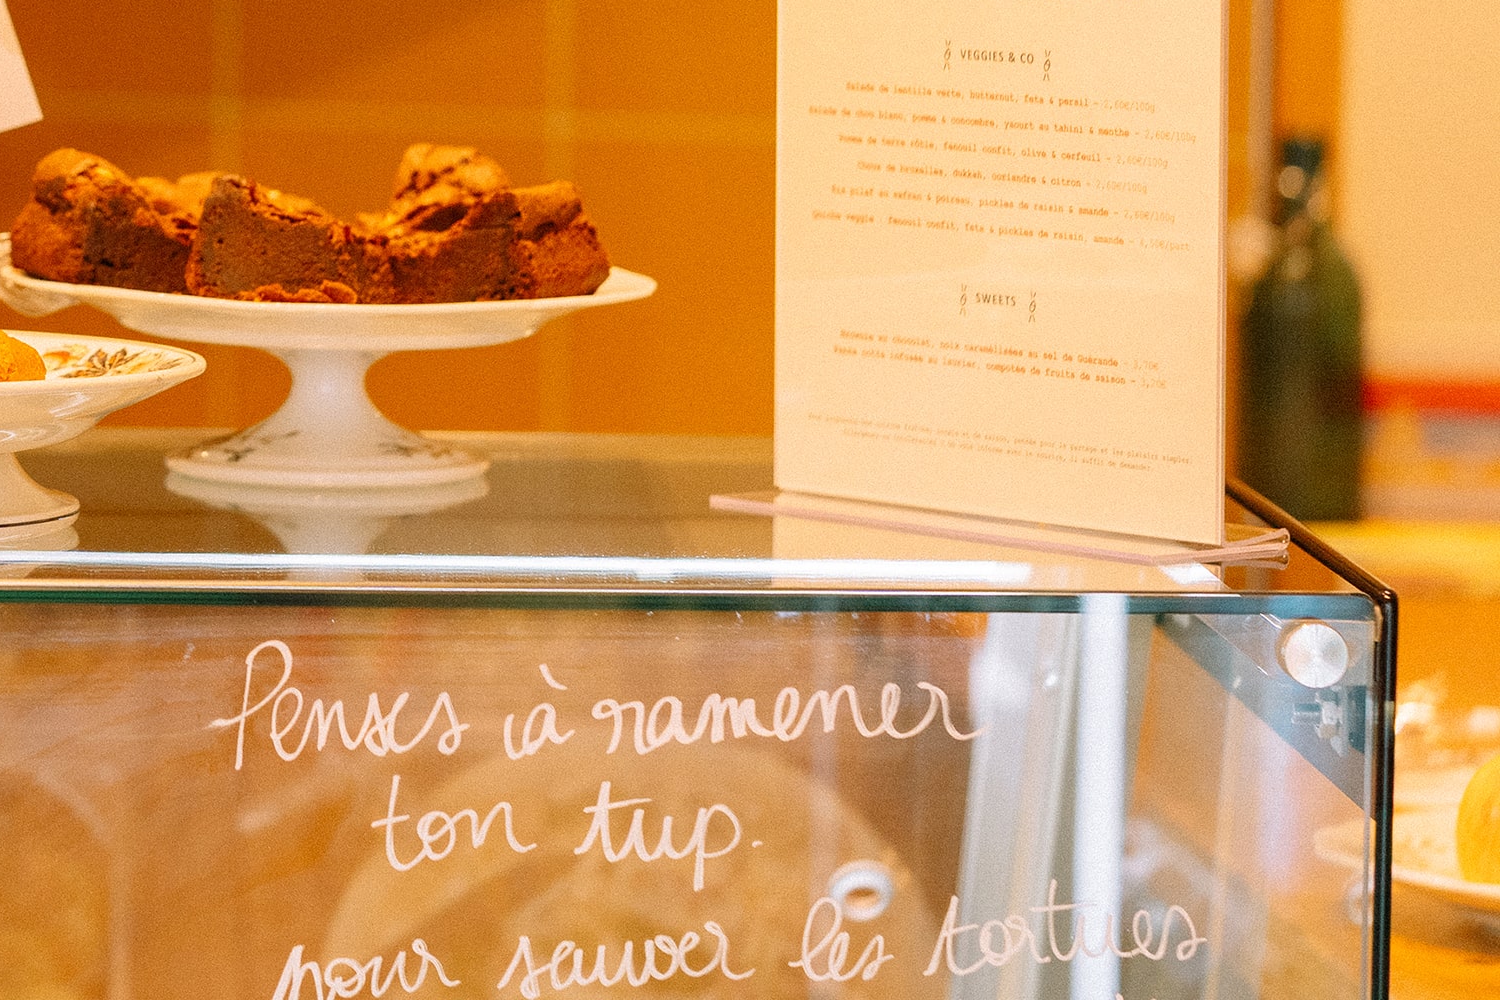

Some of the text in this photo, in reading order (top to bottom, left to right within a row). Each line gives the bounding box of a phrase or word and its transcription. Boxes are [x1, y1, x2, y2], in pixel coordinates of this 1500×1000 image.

[960, 48, 1035, 65] VEGGIES & CO
[975, 291, 1017, 307] SWEETS
[211, 639, 983, 771] Penses à ramener
[371, 774, 765, 892] ton tup.
[271, 879, 1208, 1000] pour sauver les tortues
